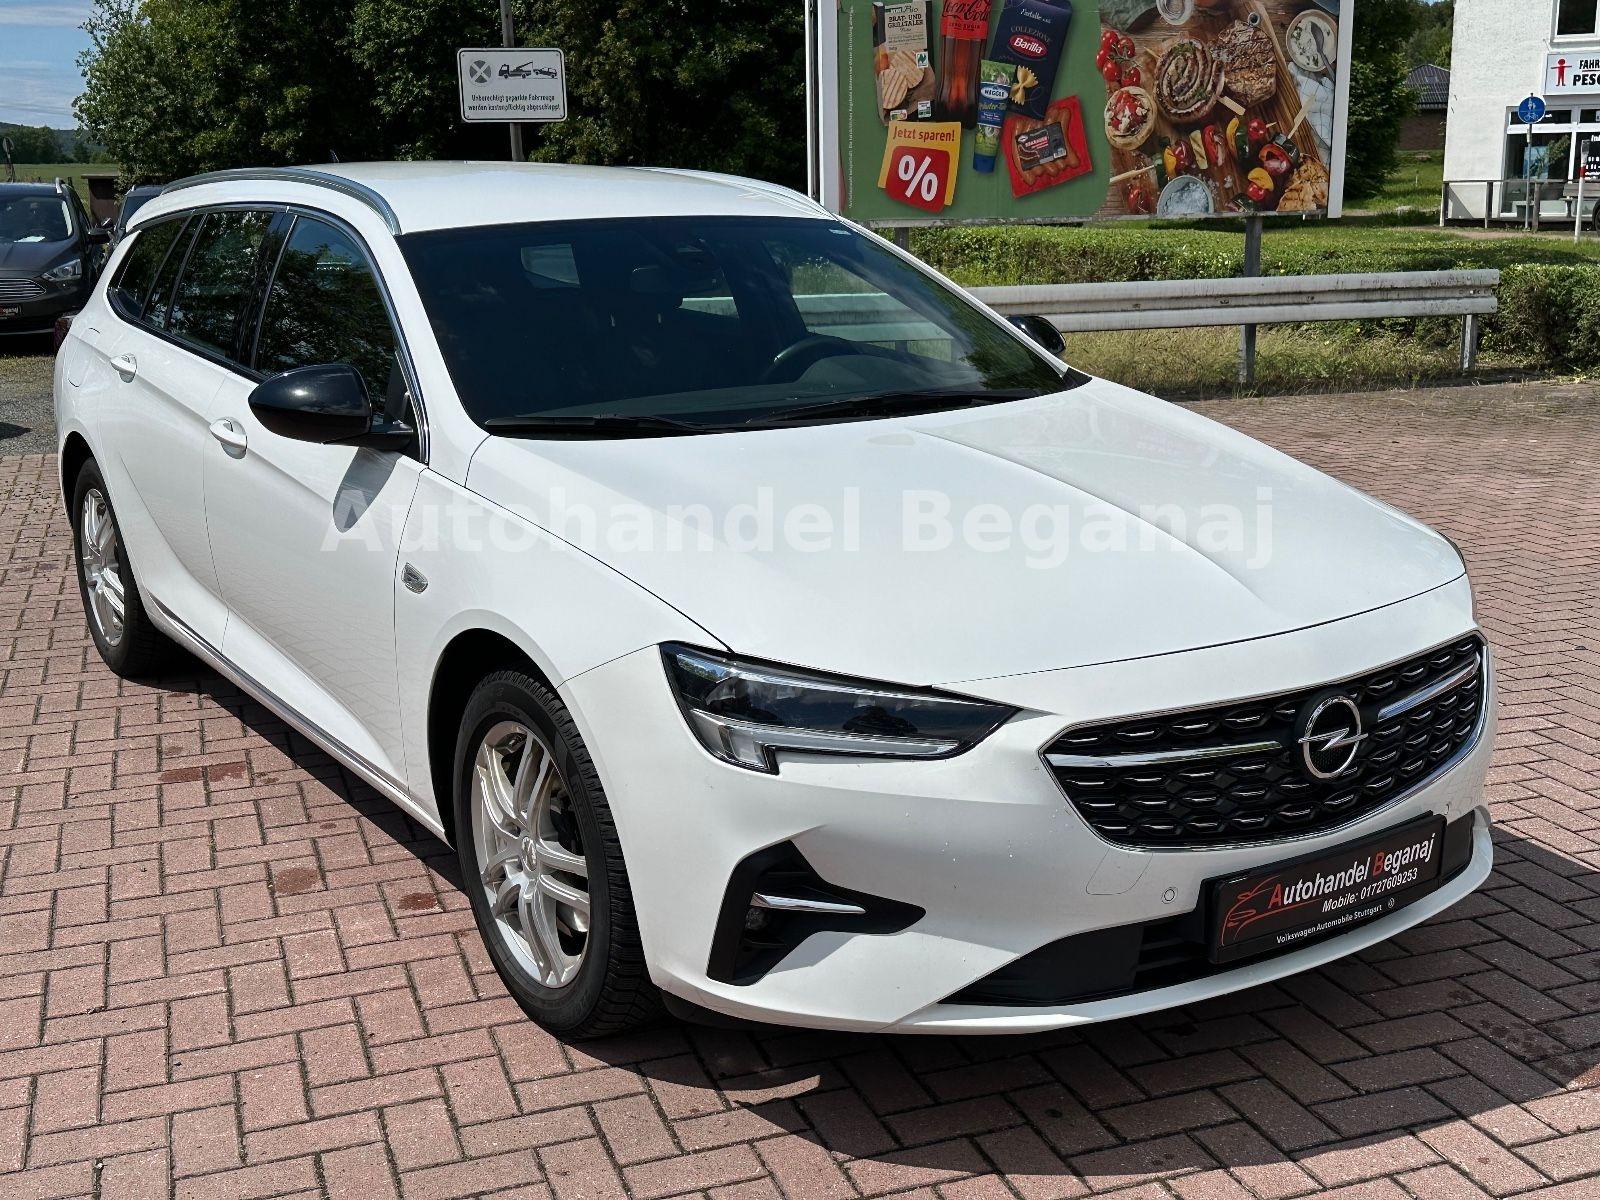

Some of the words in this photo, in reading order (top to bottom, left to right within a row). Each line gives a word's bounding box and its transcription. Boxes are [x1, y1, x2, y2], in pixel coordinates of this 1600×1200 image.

[1013, 37, 1043, 54] Barilla
[528, 93, 555, 102] Fahrzeuge
[892, 126, 916, 140] Jetzt
[918, 129, 955, 143] sparen!
[898, 154, 938, 202] %
[1267, 856, 1371, 909] Autohandel
[1372, 832, 1436, 876] Beganaj
[1321, 893, 1358, 913] Mobile:
[1360, 867, 1418, 900] 01727609253
[1276, 926, 1316, 944] Volkswagen
[1316, 914, 1353, 931] Automobile
[1354, 904, 1383, 919] Stuttgart
